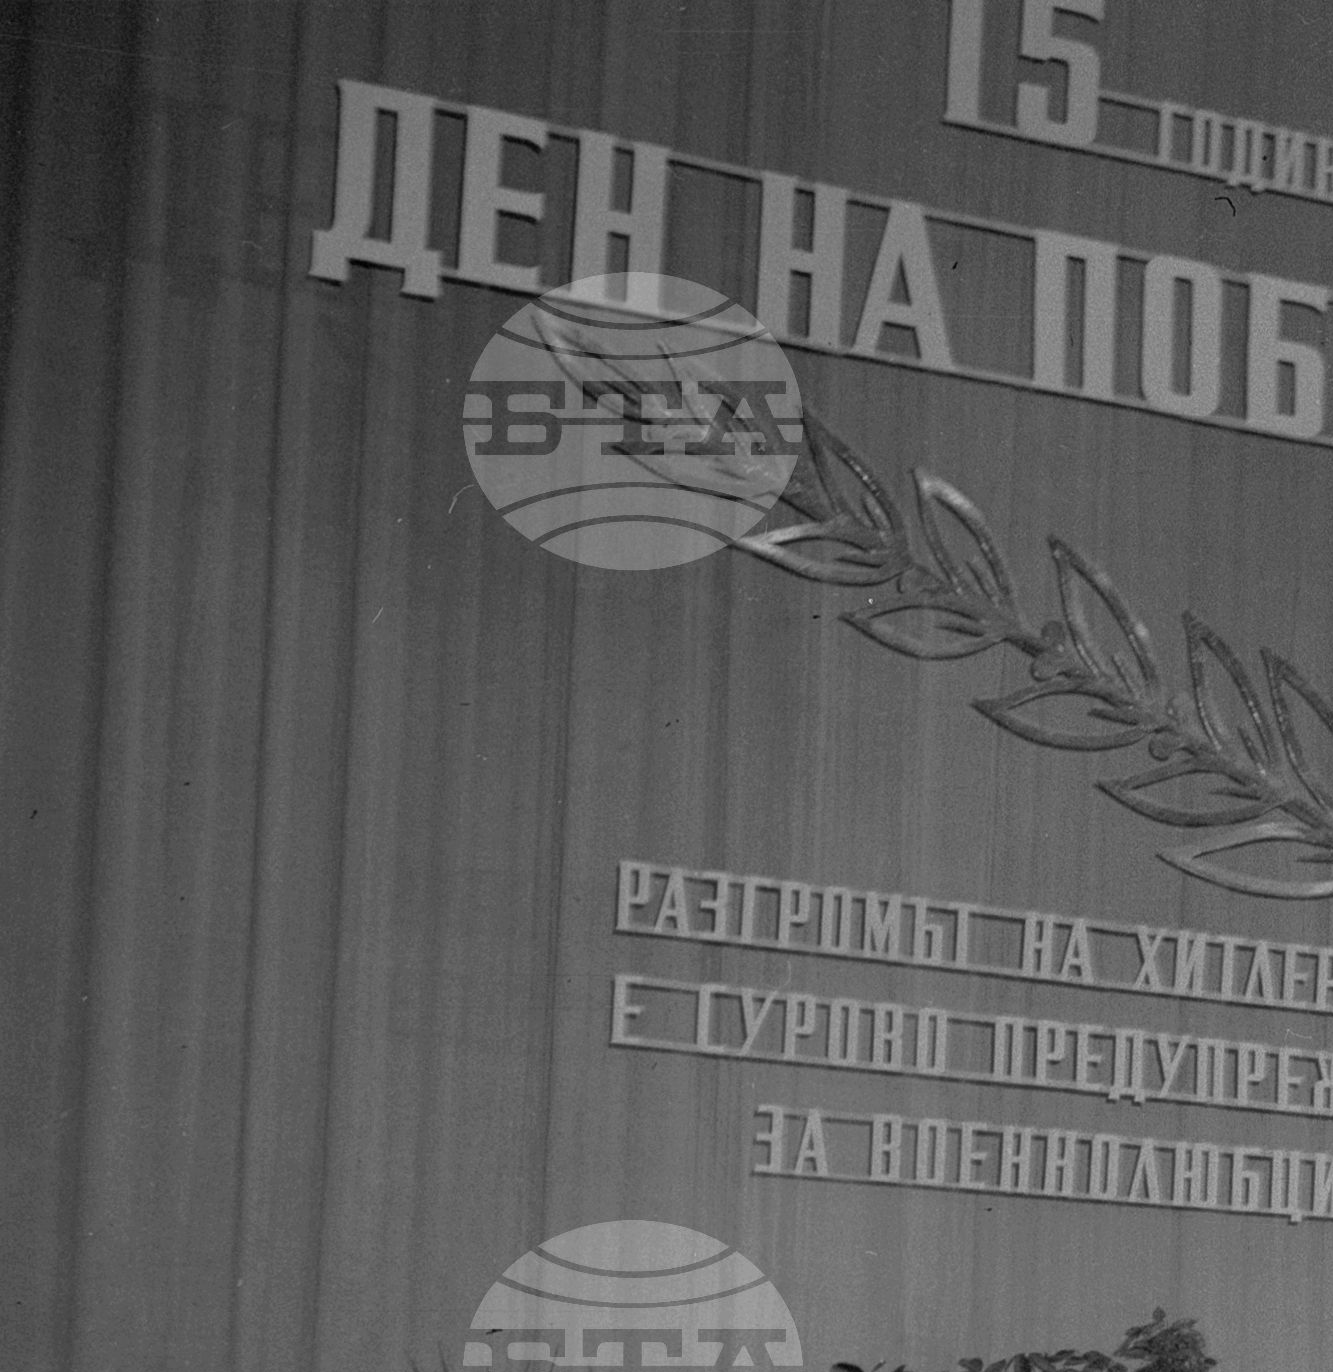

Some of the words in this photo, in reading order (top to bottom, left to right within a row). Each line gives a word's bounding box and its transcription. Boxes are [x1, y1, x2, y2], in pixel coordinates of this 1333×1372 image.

[943, 0, 1103, 145] 15
[309, 80, 674, 312] ДЕН
[755, 170, 954, 368] НА
[616, 860, 977, 969] РАЗГРОМЪТ
[1020, 911, 1096, 985] НА
[611, 974, 644, 1045] Е
[698, 983, 949, 1076] СУРОВО
[753, 1104, 829, 1178] ЗА
